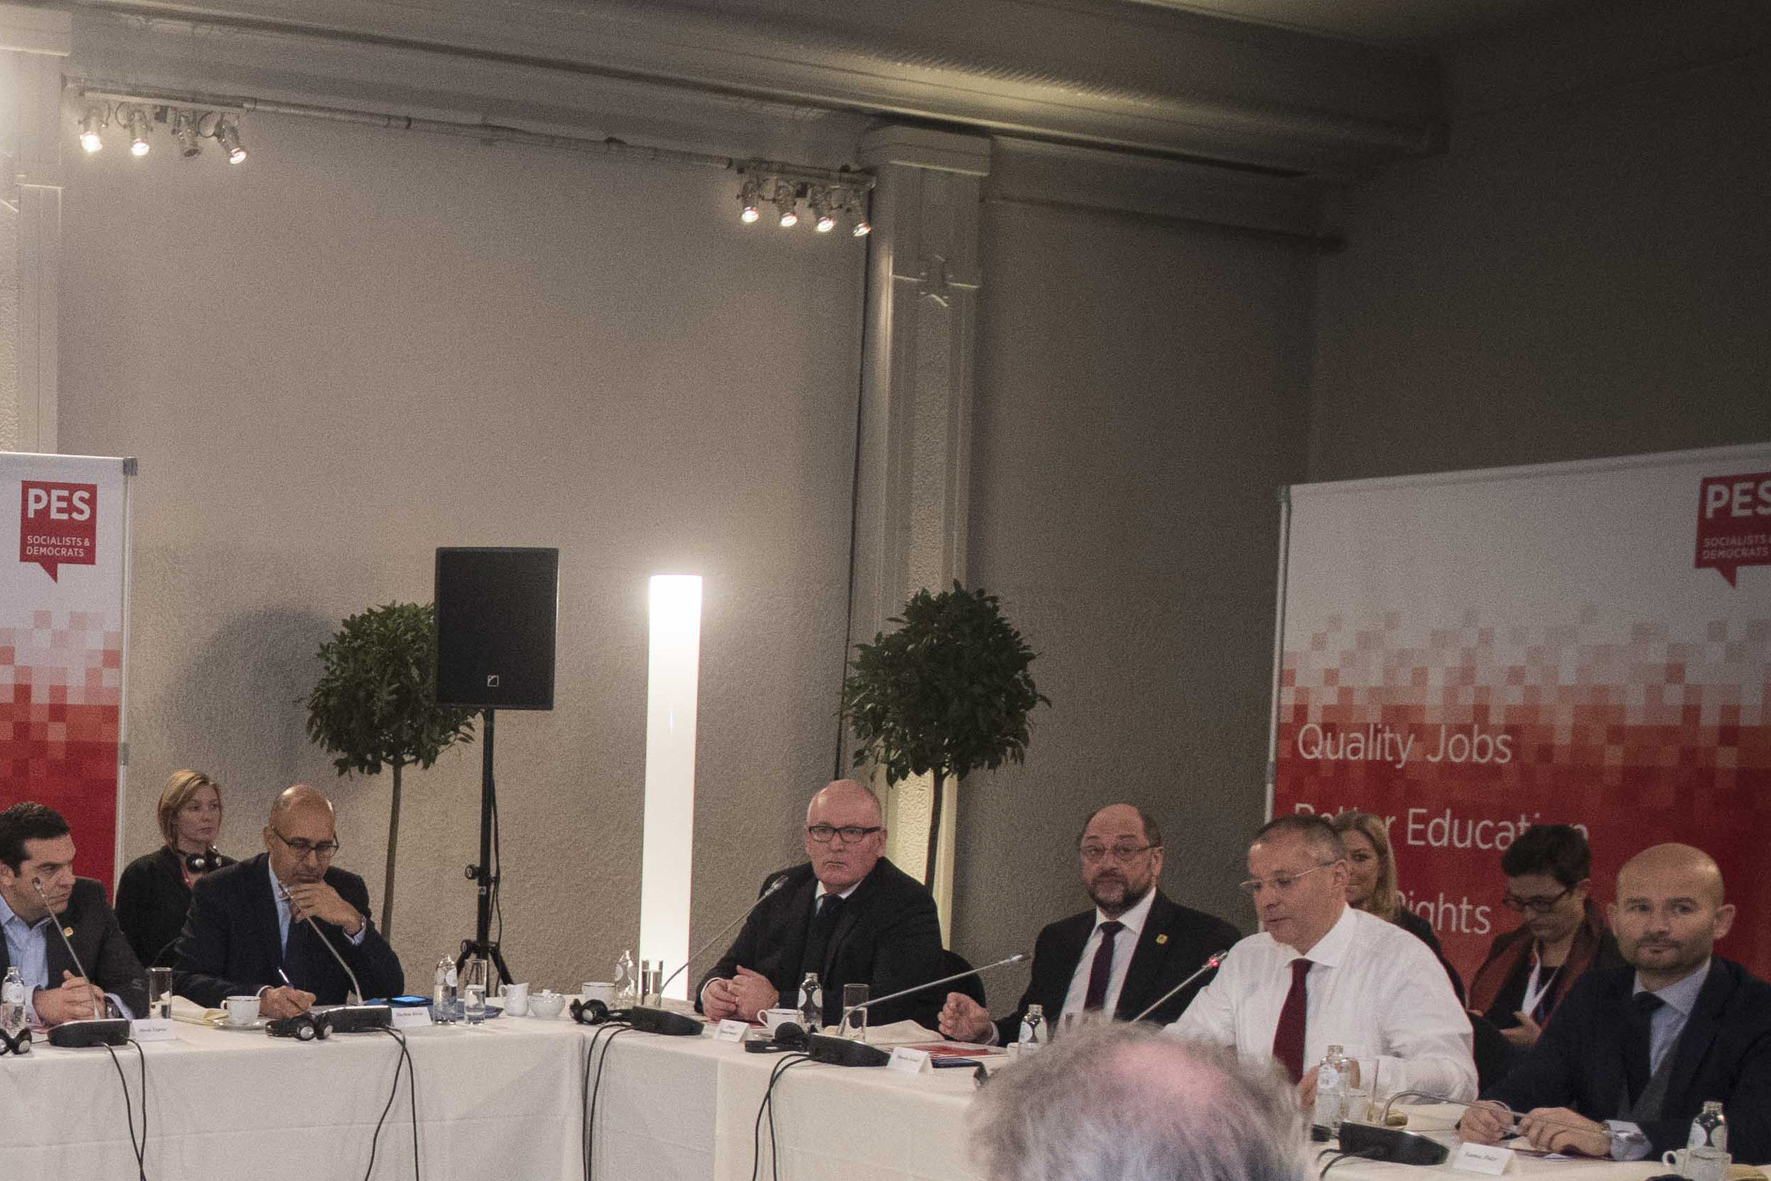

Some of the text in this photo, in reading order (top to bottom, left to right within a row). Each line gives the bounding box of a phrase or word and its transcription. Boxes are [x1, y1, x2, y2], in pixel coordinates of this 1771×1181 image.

[28, 488, 91, 521] PES
[1706, 480, 1771, 519] PES
[26, 546, 85, 557] DEMOCRATS
[27, 535, 90, 546] SOCIALISTS &
[1703, 547, 1769, 560] DEMOCRATS
[1704, 534, 1766, 548] SOCIALISTS
[1297, 722, 1513, 768] Quality Jobs
[1406, 807, 1589, 851] Educat
[1396, 889, 1491, 935] ights
